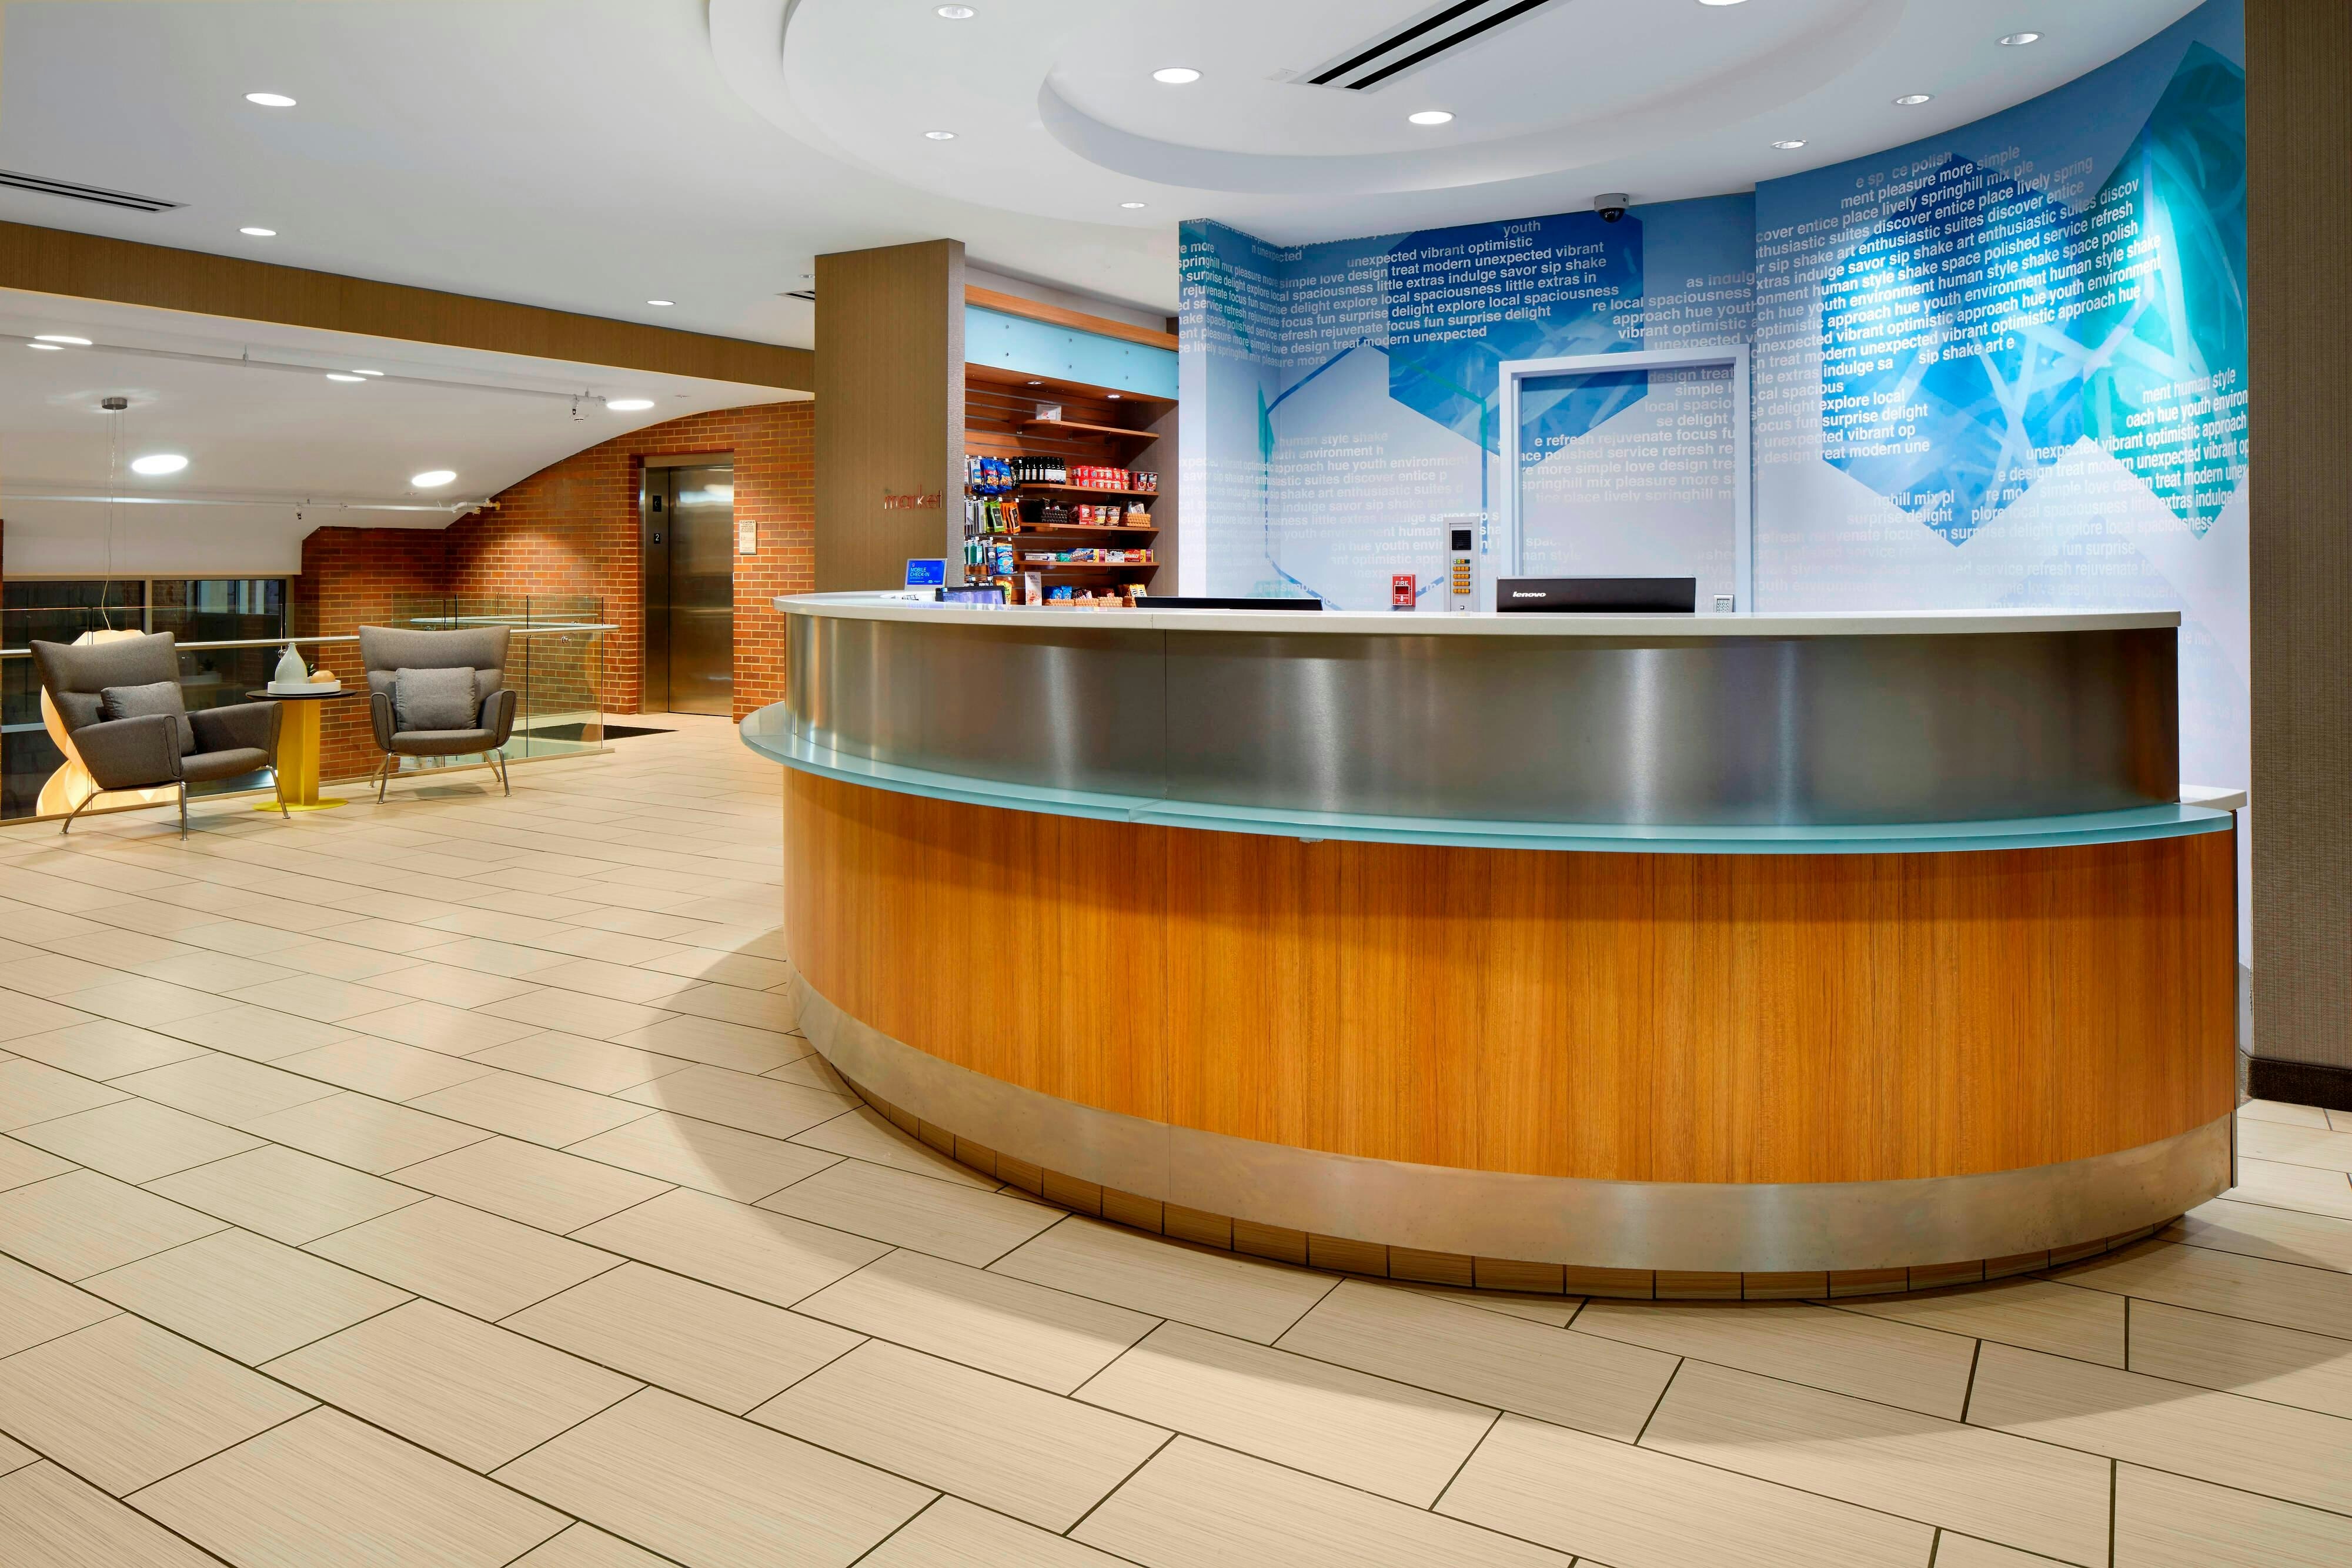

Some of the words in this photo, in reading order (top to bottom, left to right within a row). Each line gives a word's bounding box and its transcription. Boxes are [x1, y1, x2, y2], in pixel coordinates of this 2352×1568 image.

[1878, 175, 1936, 203] pleasure
[1940, 163, 1973, 182] more
[1797, 216, 1839, 235] entice
[1843, 208, 1878, 228] place
[1882, 197, 1917, 216] lively
[1921, 175, 1982, 206] springhill
[1829, 225, 1869, 244] suites
[1873, 211, 1931, 235] discover
[1935, 199, 1975, 219] entice
[1979, 186, 2013, 210] place
[2017, 173, 2050, 195] lively
[1504, 220, 1541, 238] youth
[1769, 259, 1789, 273] sip
[1793, 250, 1833, 268] shake
[1837, 245, 1855, 259] art
[1859, 225, 1940, 255] enthusiastic
[1945, 214, 1983, 235] suites
[1987, 195, 2043, 223] discover
[1795, 266, 1845, 283] indulge
[1849, 257, 1886, 275] savor
[1889, 250, 1910, 268] sip
[1913, 240, 1953, 260] shake
[1957, 233, 1975, 249] art
[1978, 210, 2056, 243] enthusiastic
[2060, 195, 2096, 219] suites
[1320, 273, 1344, 285] love
[1348, 269, 1388, 282] design
[1391, 263, 1419, 276] treat
[1423, 258, 1470, 273] modern
[1475, 248, 1551, 266] unexpected
[1556, 242, 1603, 258] vibrant
[1347, 249, 1416, 267] unexpected
[1421, 244, 1464, 259] vibrant
[1468, 236, 1532, 255] optimistic
[1812, 279, 1858, 296] human
[1862, 273, 1895, 289] style
[1897, 262, 1937, 280] shake
[1942, 252, 1981, 273] space
[1984, 232, 2040, 264] polished
[2043, 220, 2087, 244] service
[2092, 200, 2133, 229] refresh
[1187, 270, 1222, 283] surprise
[1224, 277, 1245, 291] delight
[1247, 284, 1269, 297] explore
[1271, 290, 1289, 302] local
[1292, 284, 1373, 300] spaciousness
[1377, 279, 1402, 291] little
[1406, 274, 1444, 288] extras
[1449, 270, 1496, 283] indulge
[1500, 265, 1536, 278] savor
[1541, 262, 1561, 274] sip
[1566, 257, 1606, 270] shake
[1808, 297, 1846, 317] youth
[1850, 279, 1934, 306] environment
[1938, 270, 1983, 289] human
[1987, 259, 2018, 279] style
[2022, 240, 2059, 260] shake
[2063, 236, 2099, 260] space
[2102, 220, 2138, 249] polish
[1828, 305, 1891, 328] approach
[1895, 301, 1919, 316] hue
[1923, 291, 1960, 313] youth
[1965, 270, 2046, 302] environment
[2050, 259, 2092, 281] human
[2095, 247, 2124, 269] style
[2127, 235, 2161, 258] shake
[1183, 283, 1227, 299] rejuvenate
[1229, 291, 1246, 304] focus
[1291, 300, 1329, 314] delight
[1333, 296, 1378, 310] explore
[1381, 292, 1409, 305] local
[1414, 283, 1501, 302] spaciousness
[1506, 279, 1534, 292] little
[1538, 275, 1579, 288] extras
[1585, 272, 1596, 283] in
[1194, 299, 1222, 312] service
[1224, 305, 1246, 318] refresh
[1282, 316, 1312, 327] focus
[1317, 314, 1335, 325] fun
[1339, 309, 1388, 323] surprise
[1392, 304, 1434, 317] delight
[1438, 299, 1485, 313] explore
[1489, 294, 1519, 307] local
[1524, 286, 1619, 305] spaciousness
[1611, 297, 1643, 310] local
[1649, 288, 1751, 308] spaciousness
[1836, 325, 1883, 342] vibrant
[1886, 311, 1953, 336] optimistic
[1957, 296, 2018, 323] approach
[2022, 293, 2046, 308] hue
[2050, 279, 2090, 305] youth
[2087, 254, 2161, 291] environment
[1279, 329, 1317, 341] refresh
[1321, 323, 1382, 339] rejuvenate
[1387, 320, 1420, 331] focus
[1424, 317, 1444, 327] fun
[1448, 312, 1501, 326] surprise
[1505, 305, 1551, 320] delight
[1613, 308, 1680, 326] approach
[1686, 306, 1712, 318] hue
[1618, 324, 1668, 339] vibrant
[1672, 319, 1746, 337] optimistic
[1805, 346, 1856, 362] modern
[1860, 331, 1937, 356] unexpected
[1942, 322, 1987, 342] vibrant
[1992, 307, 2054, 335] optimistic
[2058, 291, 2115, 321] approach
[2119, 285, 2140, 303] hue
[1291, 341, 1329, 353] design
[1333, 339, 1360, 350] treat
[1364, 335, 1409, 347] modern
[1414, 326, 1486, 342] unexpected
[1824, 360, 1874, 376] indulge
[1919, 349, 1939, 365] sip
[1942, 342, 1982, 360] shake
[1985, 337, 2002, 353] art
[1675, 383, 1723, 397] simple
[2213, 367, 2235, 390] style
[1820, 394, 1869, 412] explore
[1873, 389, 1905, 404] local
[1823, 410, 1878, 428] surprise
[1882, 403, 1927, 422] delight
[2157, 404, 2178, 423] hue
[2181, 395, 2210, 421] youth
[1847, 424, 1895, 441] vibrant
[2146, 422, 2199, 449] optimistic
[2203, 411, 2246, 440] approach
[2137, 442, 2200, 470] unexpected
[2204, 438, 2237, 459] vibrant
[2155, 471, 2181, 489] treat
[2184, 463, 2222, 482] modern
[884, 484, 943, 510] market
